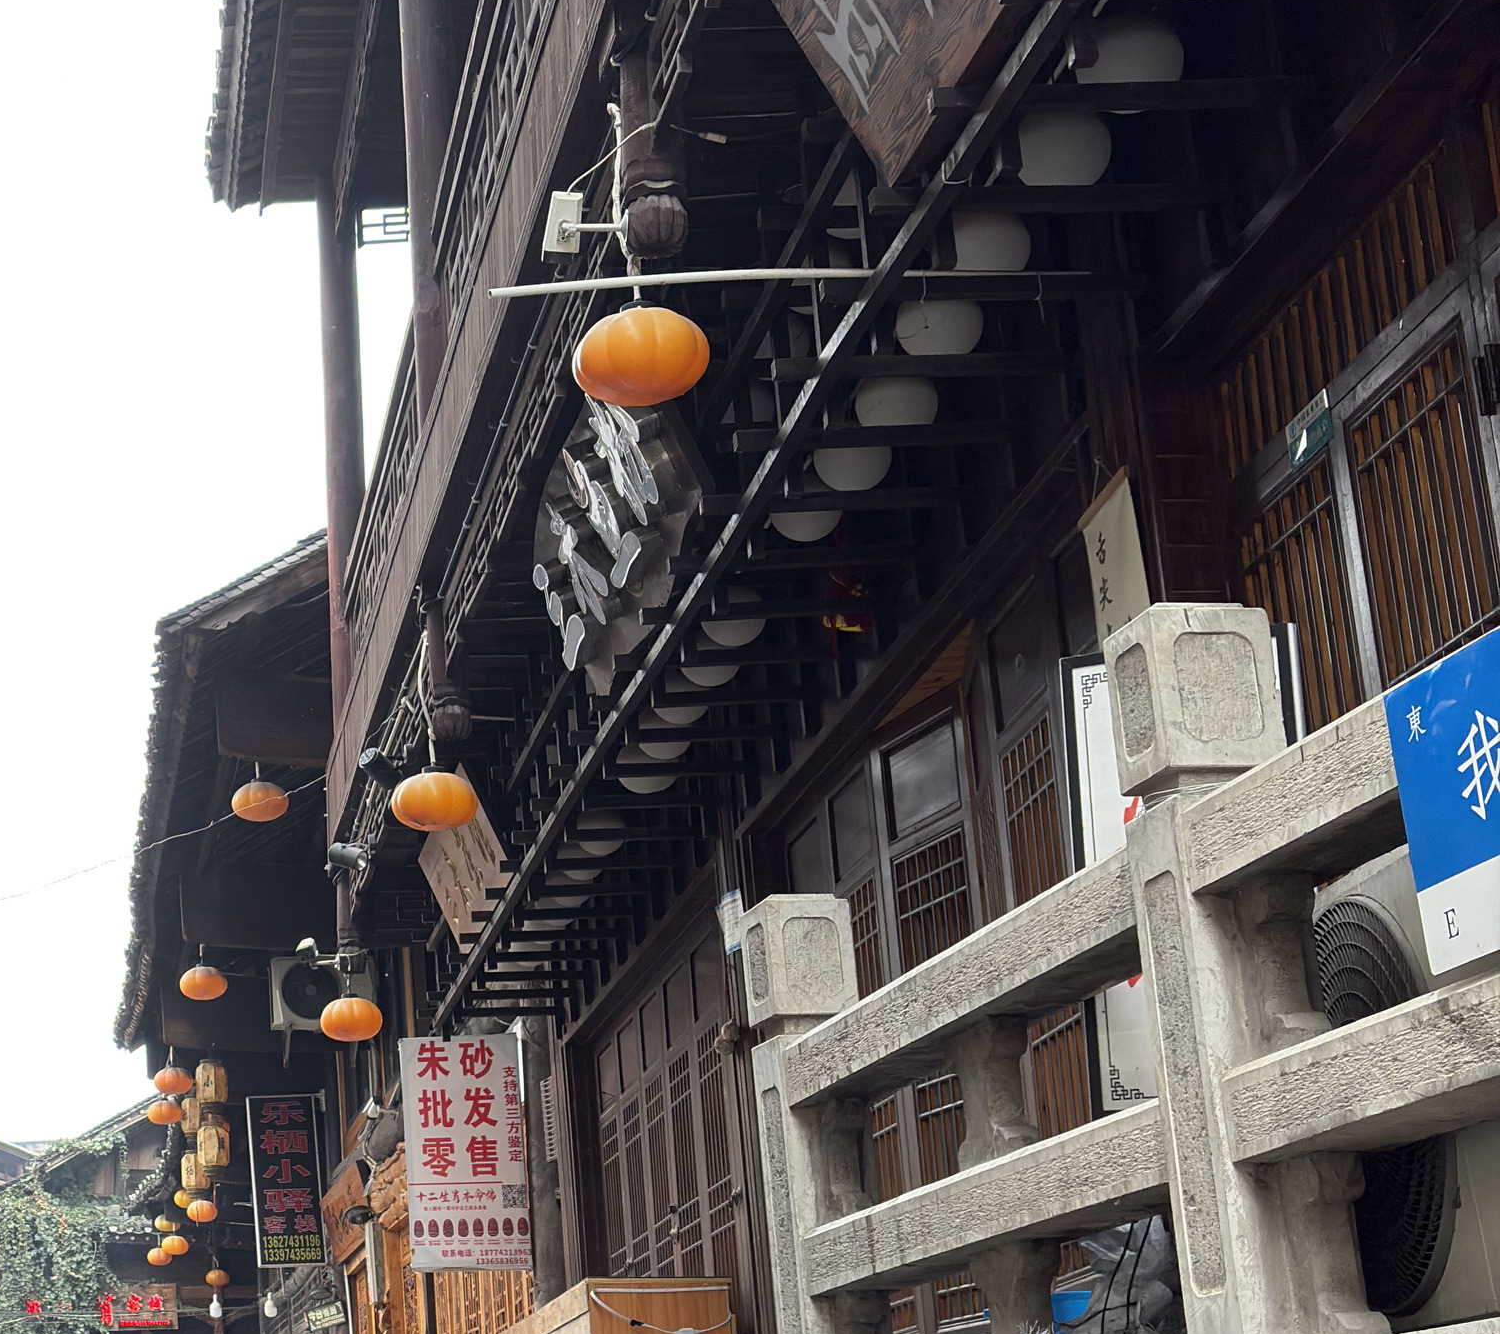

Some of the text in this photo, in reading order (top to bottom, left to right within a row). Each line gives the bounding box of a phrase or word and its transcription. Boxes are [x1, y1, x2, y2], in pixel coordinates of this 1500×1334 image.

[1406, 705, 1427, 742] 東
[1443, 908, 1460, 940] E
[416, 1039, 495, 1081] 朱砂
[418, 1087, 498, 1128] 批发
[502, 1066, 524, 1163] 支持第三方鉴定
[260, 1100, 314, 1213] 乐栖小驿
[422, 1135, 499, 1177] 零售
[263, 1215, 318, 1234] 客栈
[263, 1233, 321, 1249] 13627431196
[263, 1247, 322, 1262] 13397435669
